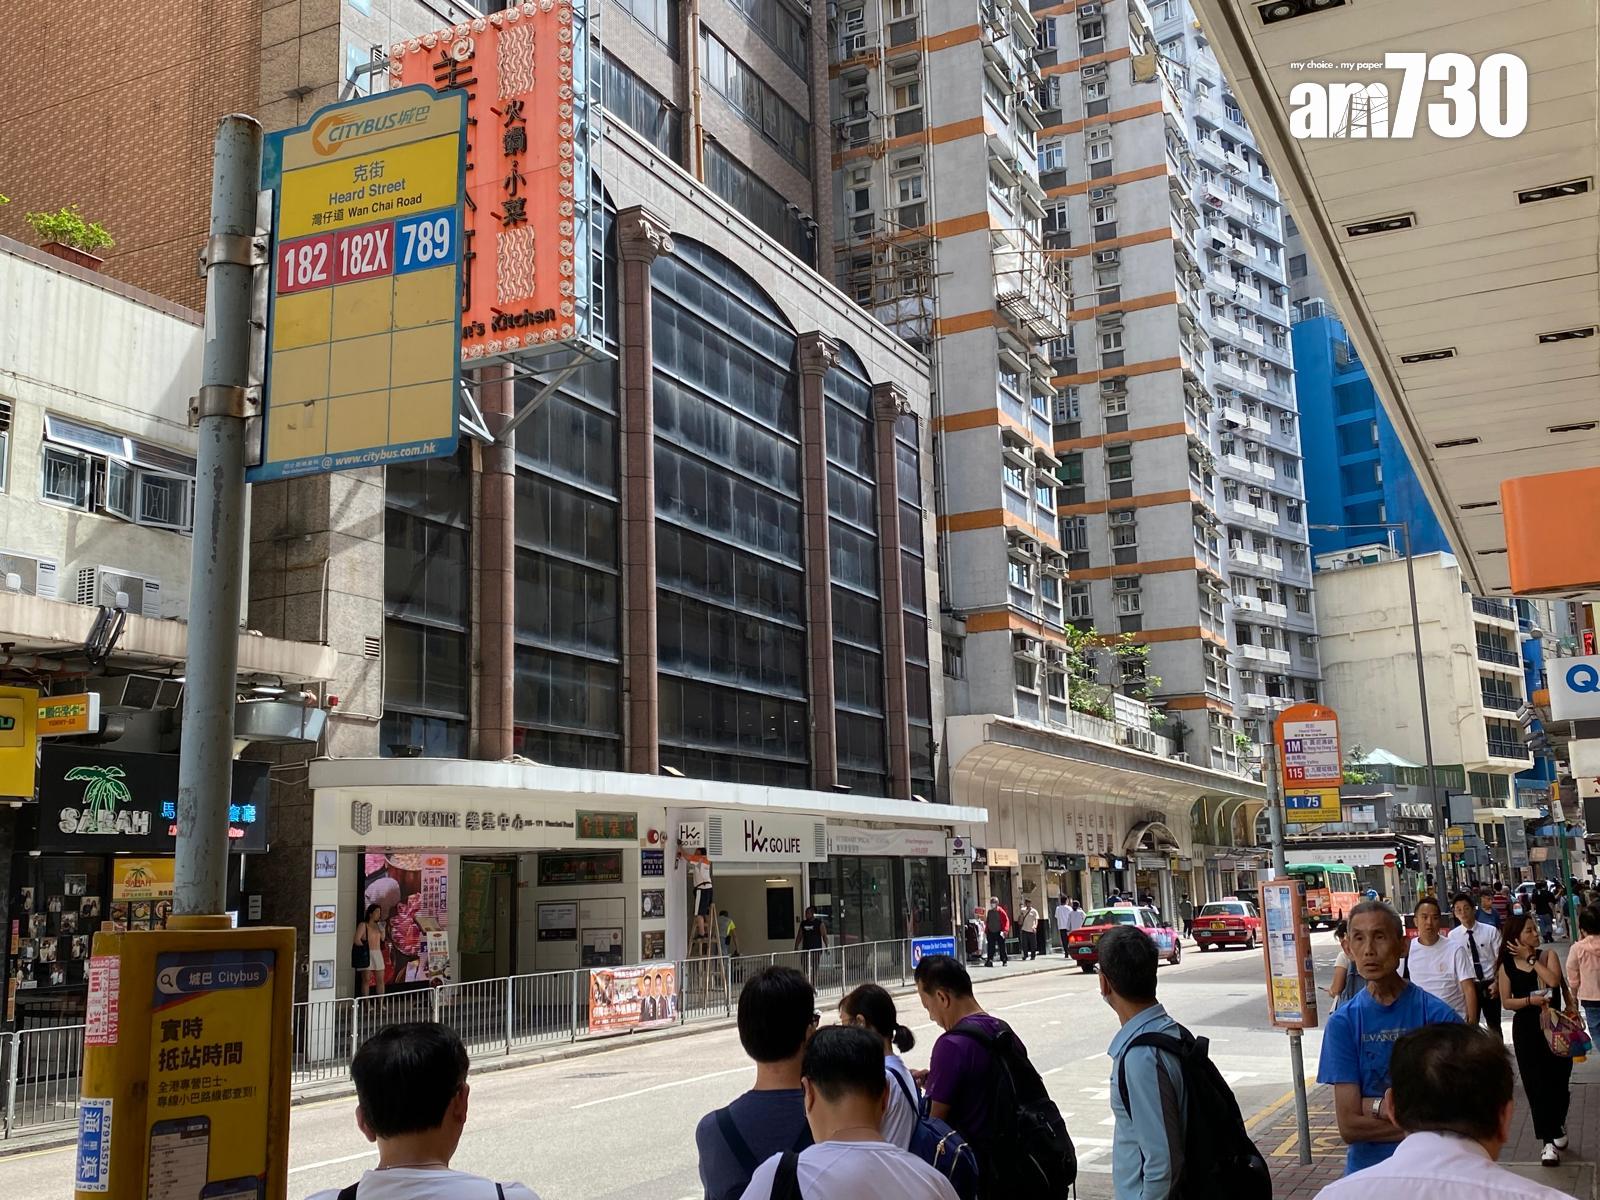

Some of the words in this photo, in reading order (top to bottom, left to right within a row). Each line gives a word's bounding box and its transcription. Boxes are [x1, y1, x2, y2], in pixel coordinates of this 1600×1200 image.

[328, 113, 398, 142] CITYBUS
[398, 106, 430, 125] 城巴
[353, 160, 384, 183] 克街
[329, 186, 365, 206] Heard
[369, 179, 406, 197] Street
[312, 208, 344, 226] 灣仔道
[348, 206, 369, 218] Wan
[371, 200, 394, 213] Chai
[396, 193, 422, 208] Road
[340, 229, 389, 277] 182X
[402, 218, 450, 266] 789
[285, 242, 328, 287] 182
[335, 442, 436, 467] www.citybus.com.hk
[1286, 741, 1301, 753] 1M
[1288, 768, 1303, 779] 115
[1306, 796, 1319, 807] 75
[378, 810, 417, 826] LUCKY
[418, 811, 461, 827] CENTRE
[769, 838, 783, 853] GO
[784, 838, 801, 853] LIFE
[188, 972, 212, 986] 城巴
[218, 966, 260, 985] Citybus
[160, 1017, 204, 1043] 實時
[159, 1041, 243, 1073] 抵站時間
[100, 1115, 112, 1176] 67913579
